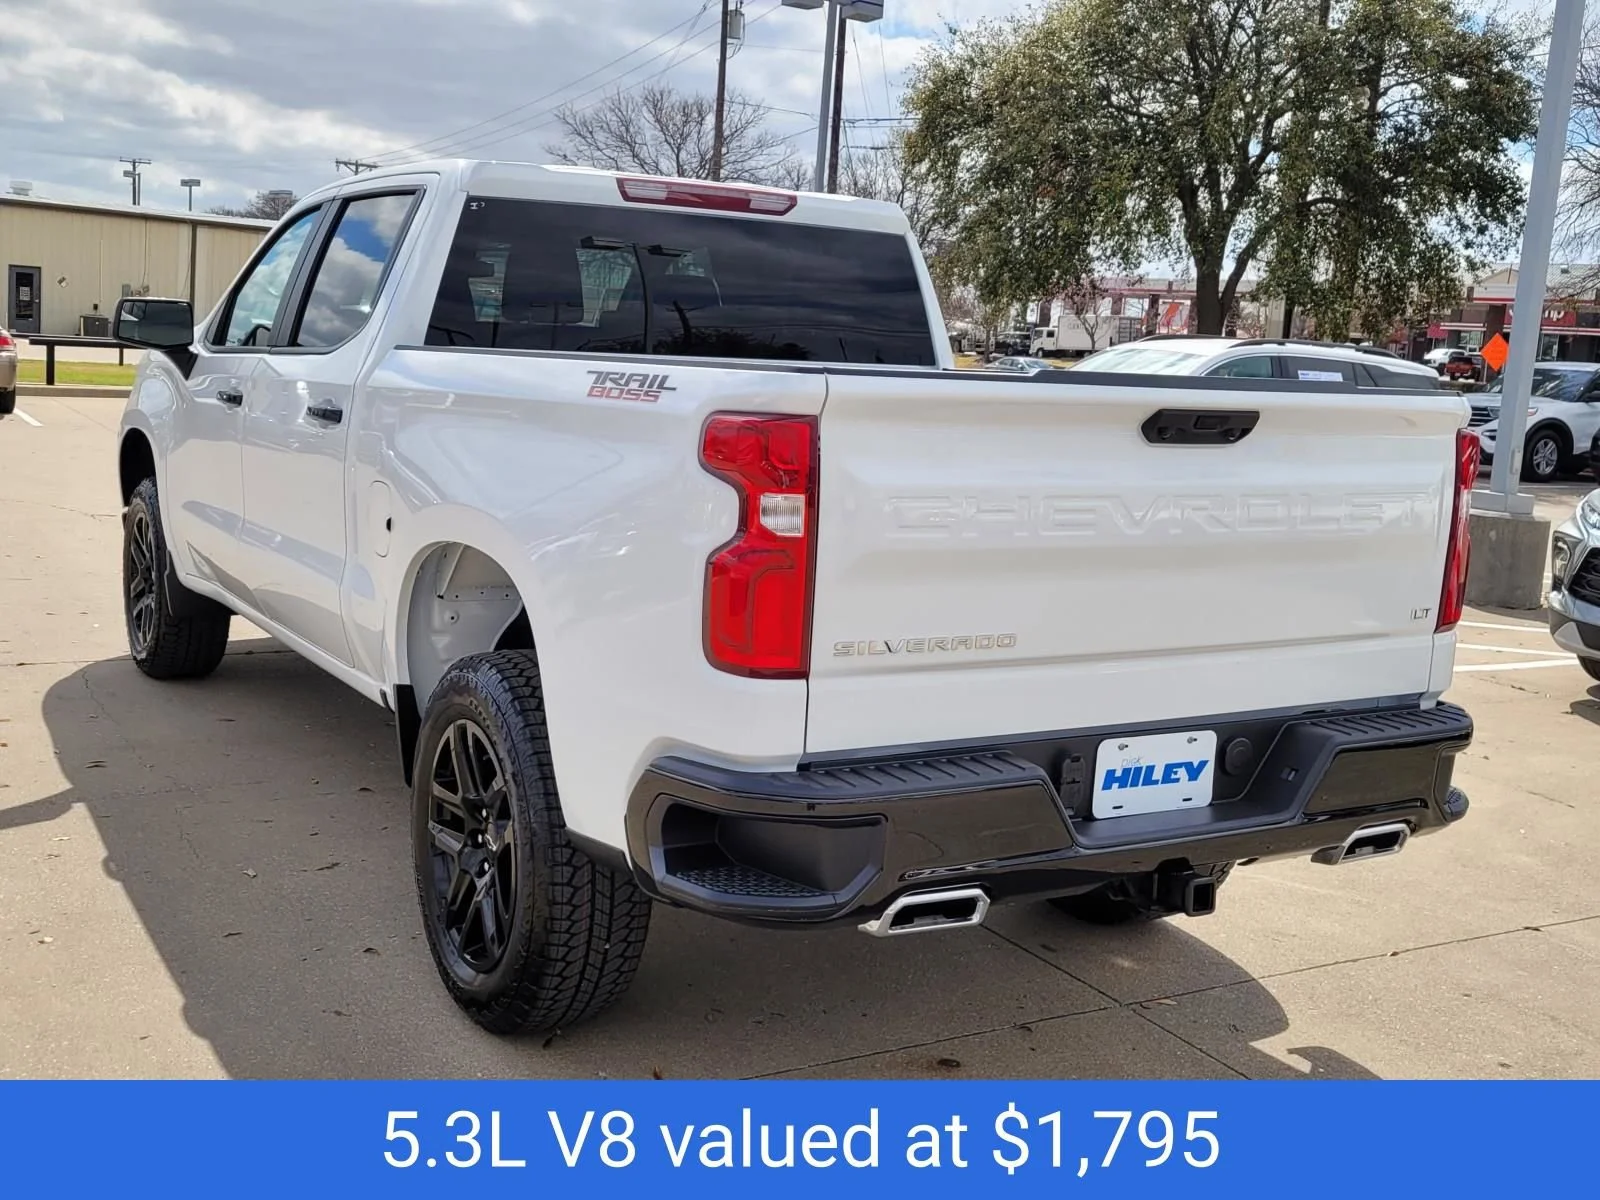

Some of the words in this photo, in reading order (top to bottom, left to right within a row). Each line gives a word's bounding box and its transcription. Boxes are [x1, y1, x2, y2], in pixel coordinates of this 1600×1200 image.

[586, 370, 677, 391] TRAIL
[586, 385, 662, 403] BOSS
[884, 491, 1432, 538] CHEVROLET
[1410, 607, 1432, 620] LT
[833, 633, 1017, 657] SILVERADO
[1101, 760, 1209, 791] HILEY
